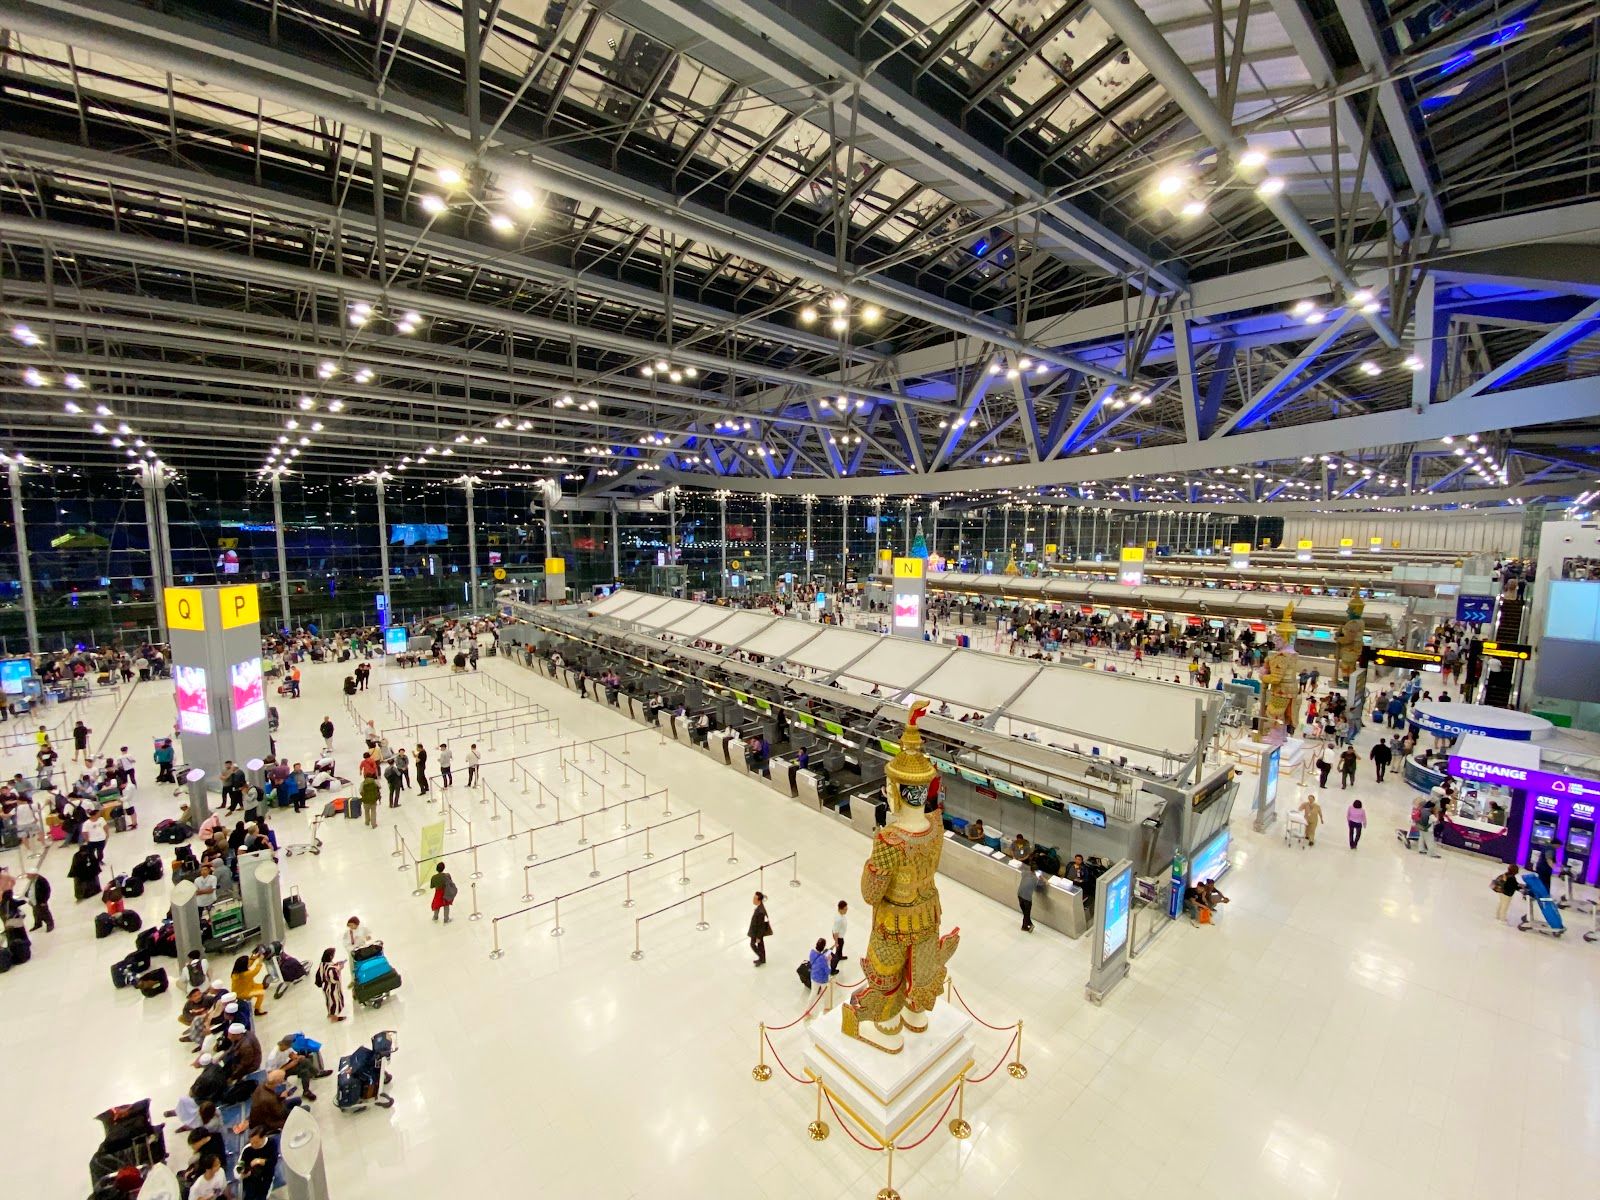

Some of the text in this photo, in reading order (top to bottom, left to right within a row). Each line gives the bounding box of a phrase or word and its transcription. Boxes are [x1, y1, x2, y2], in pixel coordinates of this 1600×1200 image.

[904, 563, 913, 573] N
[178, 598, 191, 620] Q
[234, 595, 246, 618] P
[1460, 760, 1527, 780] EXCHANGE
[1536, 795, 1559, 806] ATM
[1572, 803, 1595, 813] ATM
